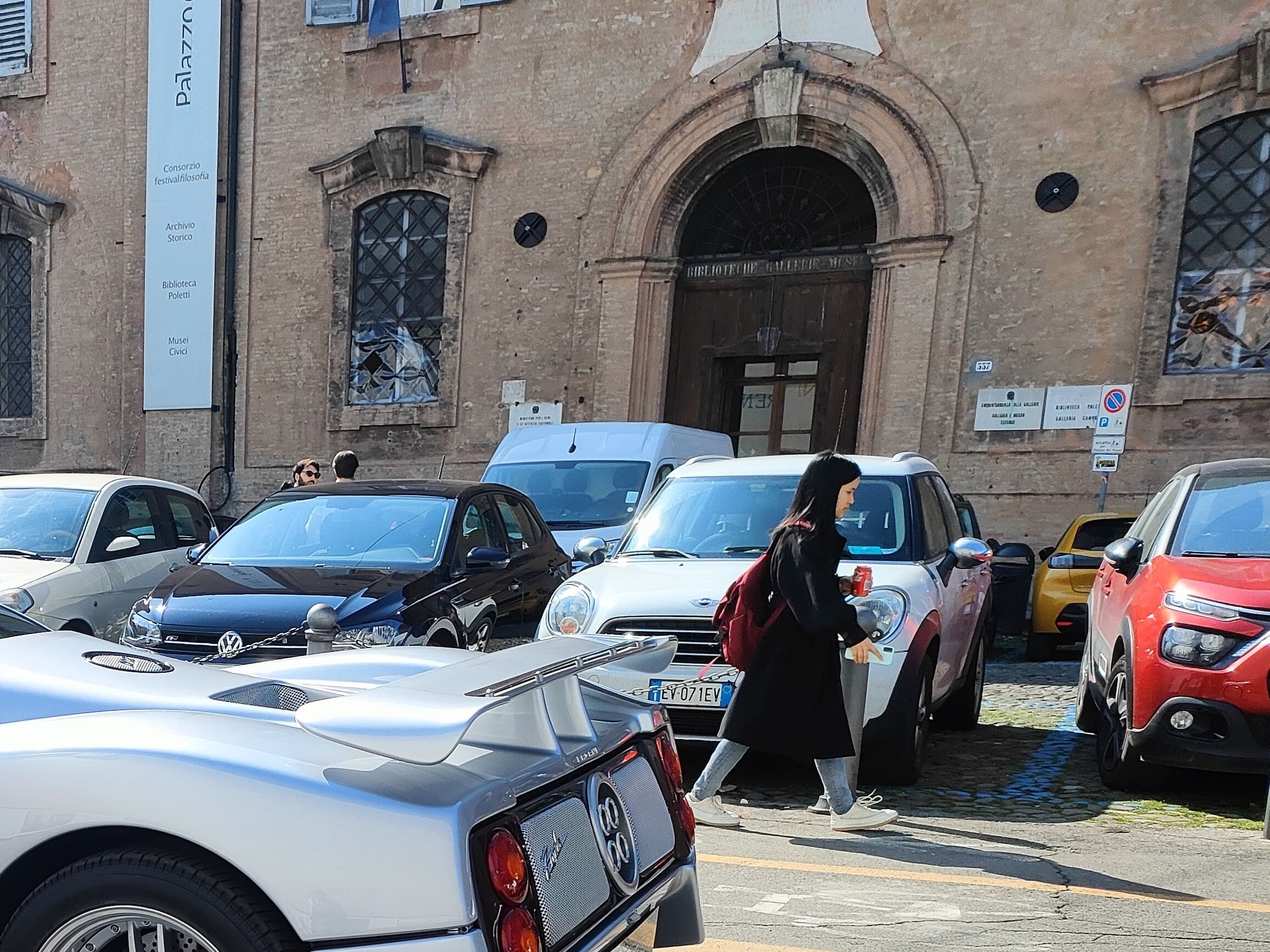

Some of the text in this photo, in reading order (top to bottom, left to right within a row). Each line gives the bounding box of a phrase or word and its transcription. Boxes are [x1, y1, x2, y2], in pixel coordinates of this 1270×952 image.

[174, 6, 193, 107] Palazzo
[163, 161, 201, 173] Consorzio
[154, 171, 210, 186] festivalfilosofia
[165, 221, 195, 231] Archivio
[167, 233, 193, 243] Storico
[687, 263, 758, 279] BIBLIOTECHE
[162, 280, 197, 289] Biblioteca
[168, 291, 190, 300] Poletti
[168, 336, 189, 345] Musei
[168, 347, 188, 356] Civici
